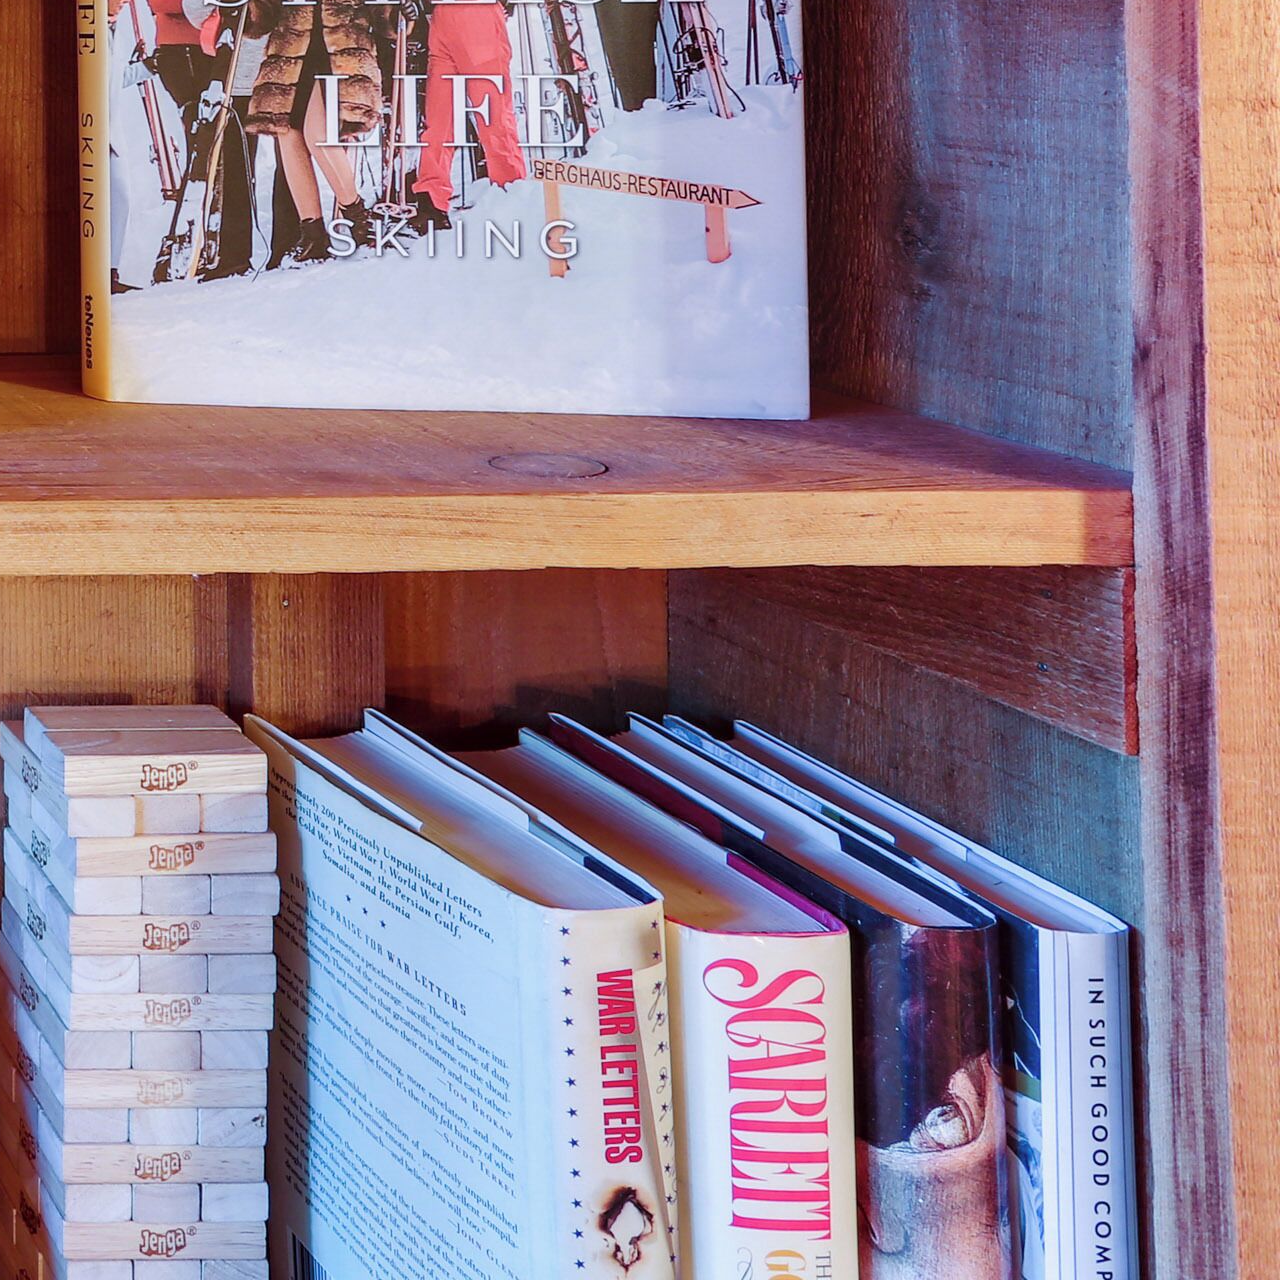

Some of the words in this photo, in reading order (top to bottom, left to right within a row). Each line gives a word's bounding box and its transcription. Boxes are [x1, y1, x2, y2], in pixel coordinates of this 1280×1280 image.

[313, 73, 588, 149] LIFE
[81, 112, 95, 239] SKIING
[534, 160, 735, 206] BERGHAUS-RESTAURANT
[328, 218, 581, 260] SKIING
[84, 294, 94, 370] teNeues
[321, 804, 336, 823] 200
[338, 814, 381, 854] Previously
[383, 846, 443, 893] Unpublished
[446, 888, 483, 917] Letters
[360, 879, 377, 896] and
[379, 890, 411, 920] Bosnia
[596, 969, 635, 1037] WAR
[1088, 977, 1104, 1005] IN
[1089, 1019, 1106, 1088] SUCH
[598, 1043, 643, 1165] LETTERS
[702, 957, 833, 1242] SCARLETT
[1090, 1102, 1110, 1187] GOOD
